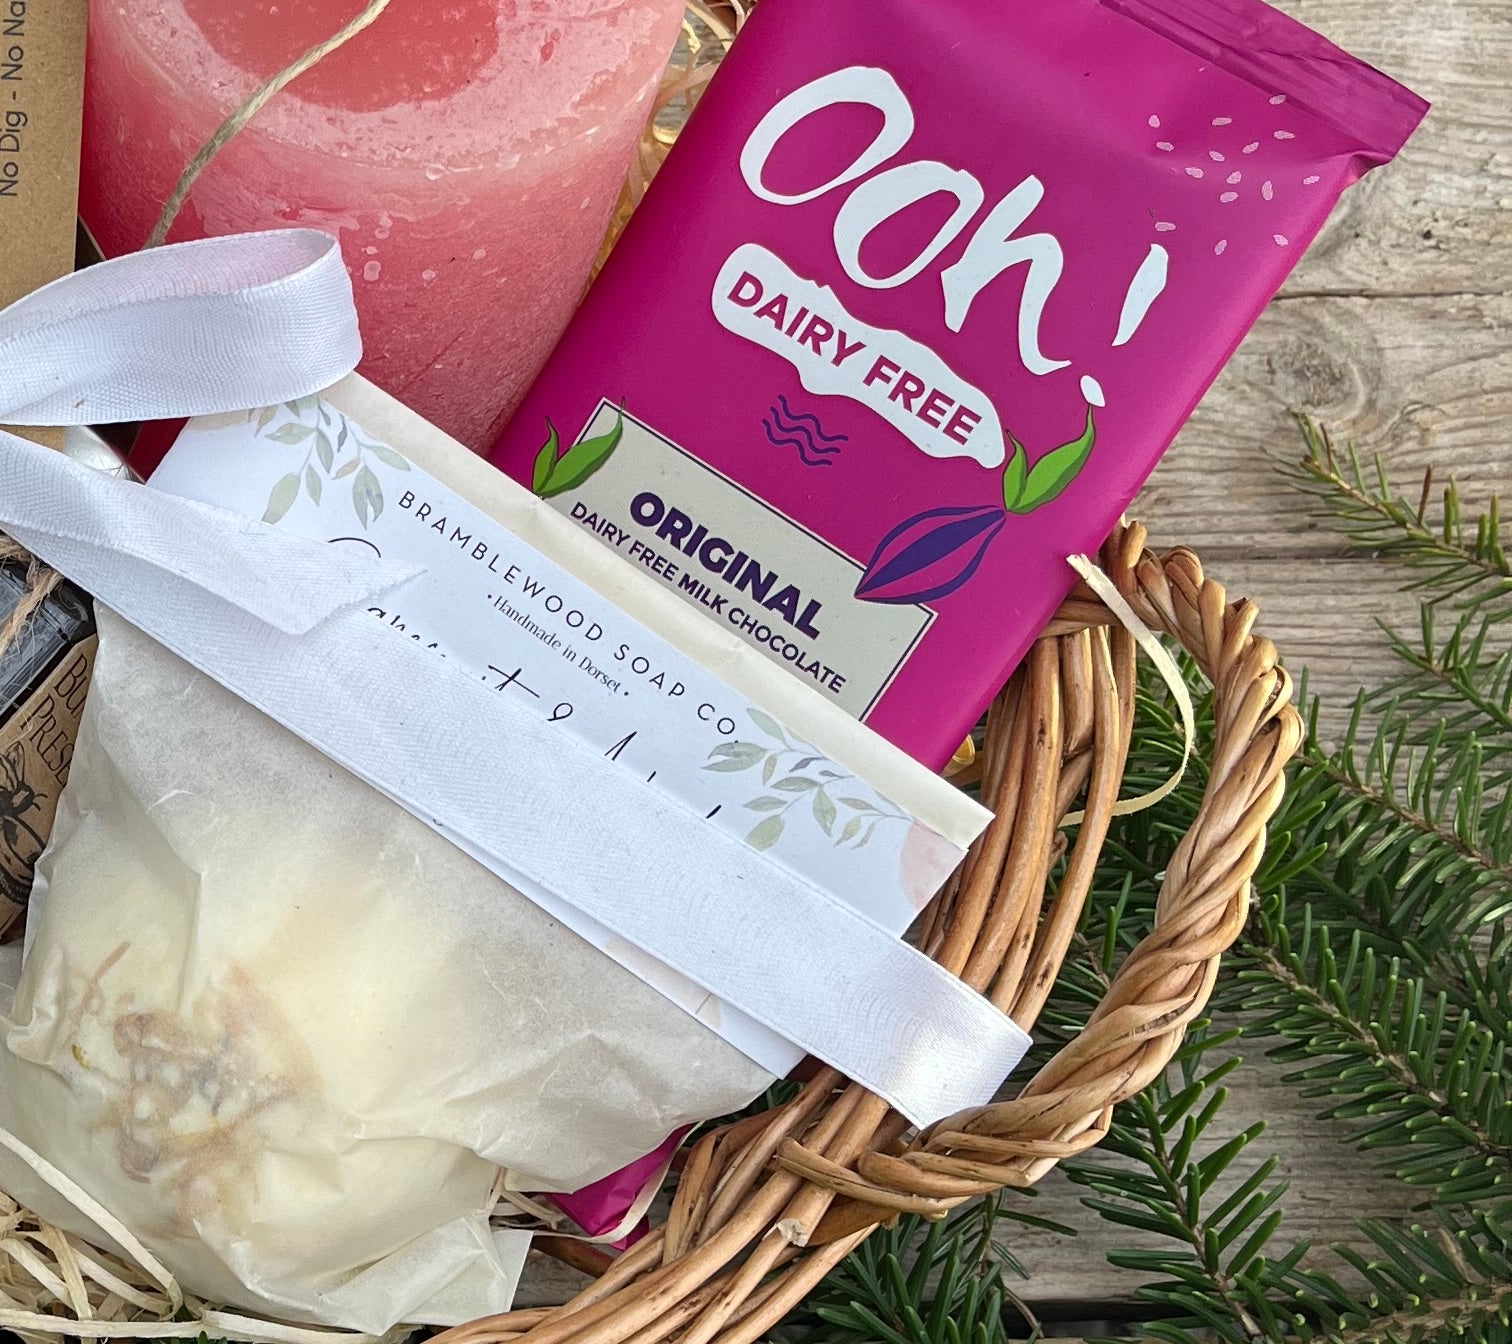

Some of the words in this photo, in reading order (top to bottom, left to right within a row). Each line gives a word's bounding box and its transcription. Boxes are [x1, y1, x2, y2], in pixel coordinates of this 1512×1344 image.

[1, 44, 24, 81] No
[740, 66, 1168, 407] Ooh!
[728, 270, 867, 367] DAIRY
[864, 355, 982, 447] FREE
[398, 490, 603, 642] BRAMBLEWOOD
[613, 644, 685, 699] SOAP
[493, 595, 562, 651] Handmade
[562, 644, 578, 662] in
[579, 656, 622, 694] Dorset
[570, 502, 630, 547] DAIRY
[629, 539, 679, 582] FREE
[678, 573, 728, 614] MILK
[728, 608, 846, 694] CHOCOLATE
[630, 492, 822, 640] ORIGINAL
